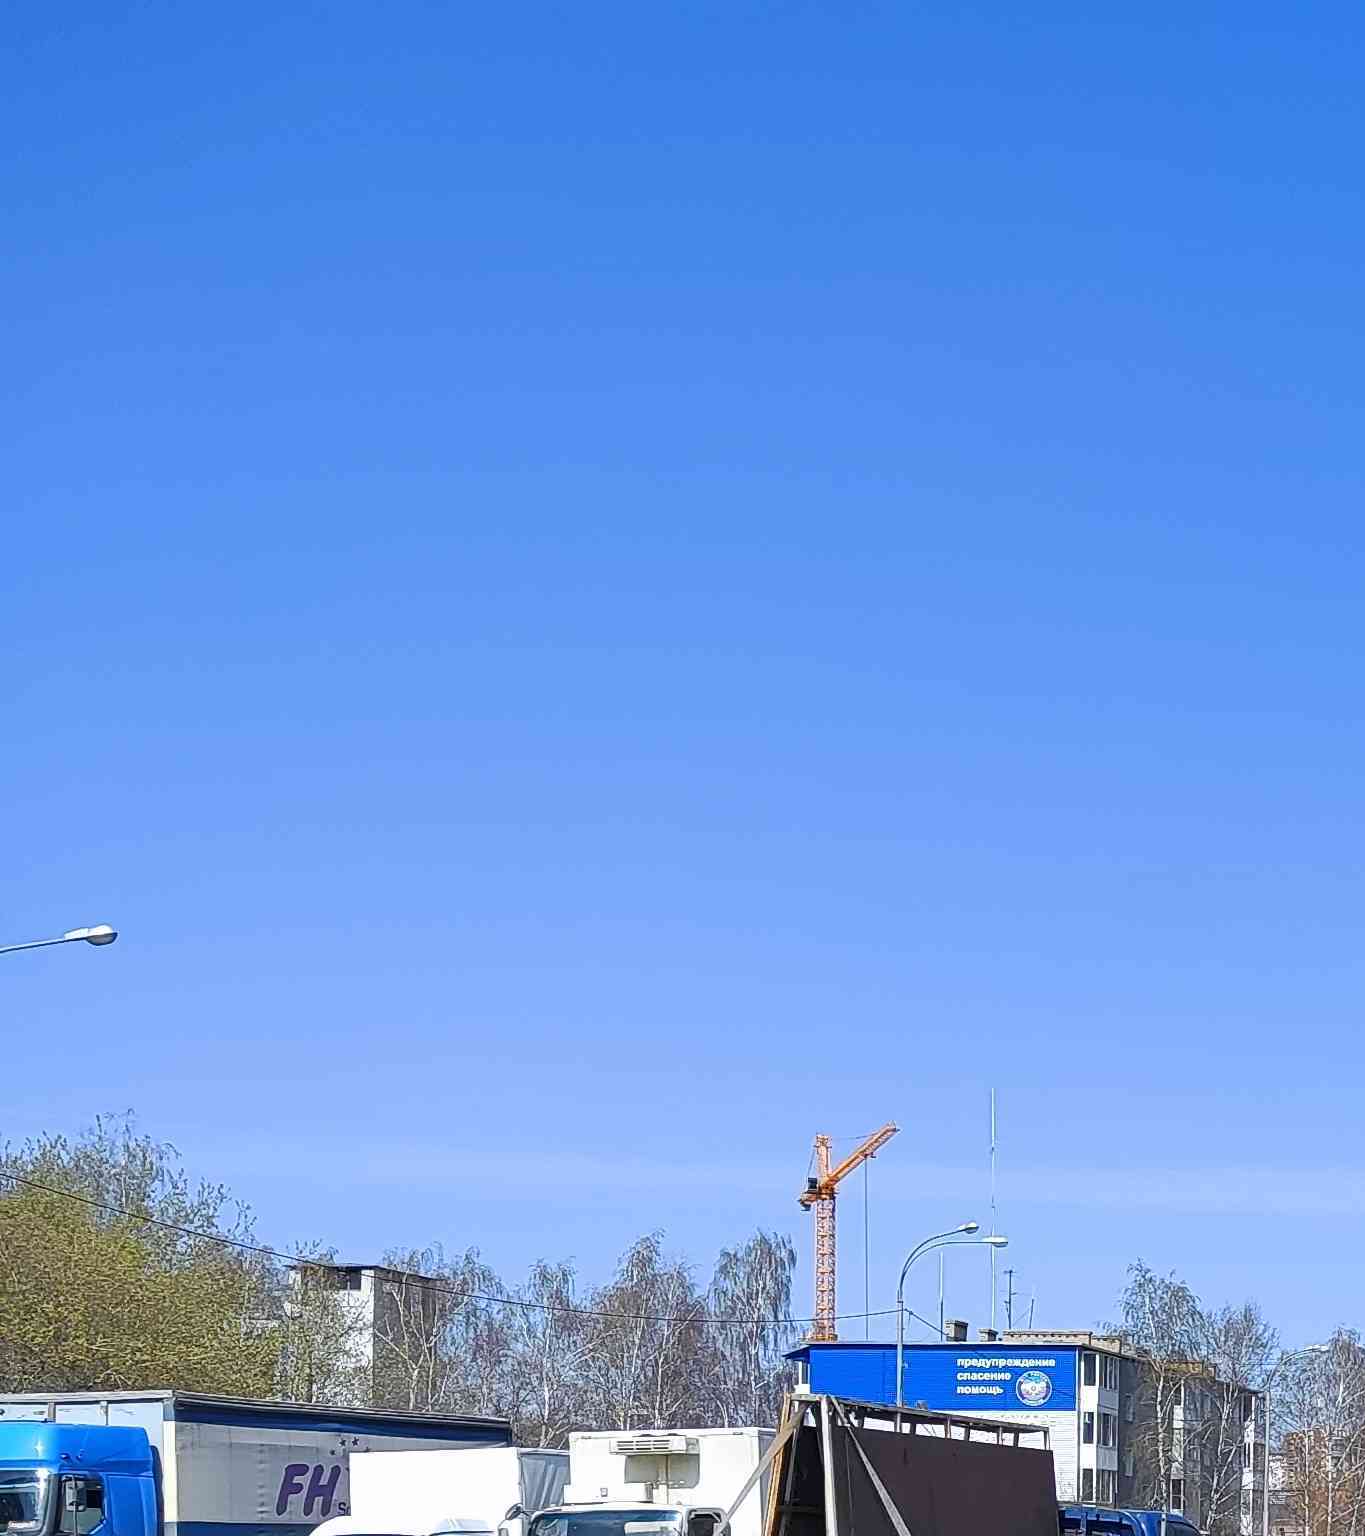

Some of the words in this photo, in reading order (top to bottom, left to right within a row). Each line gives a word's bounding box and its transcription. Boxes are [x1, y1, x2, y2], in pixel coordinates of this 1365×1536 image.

[956, 1358, 1056, 1368] предупреждение
[956, 1371, 1012, 1381] спасение
[956, 1385, 1004, 1395] помощь
[275, 1463, 349, 1518] FH
